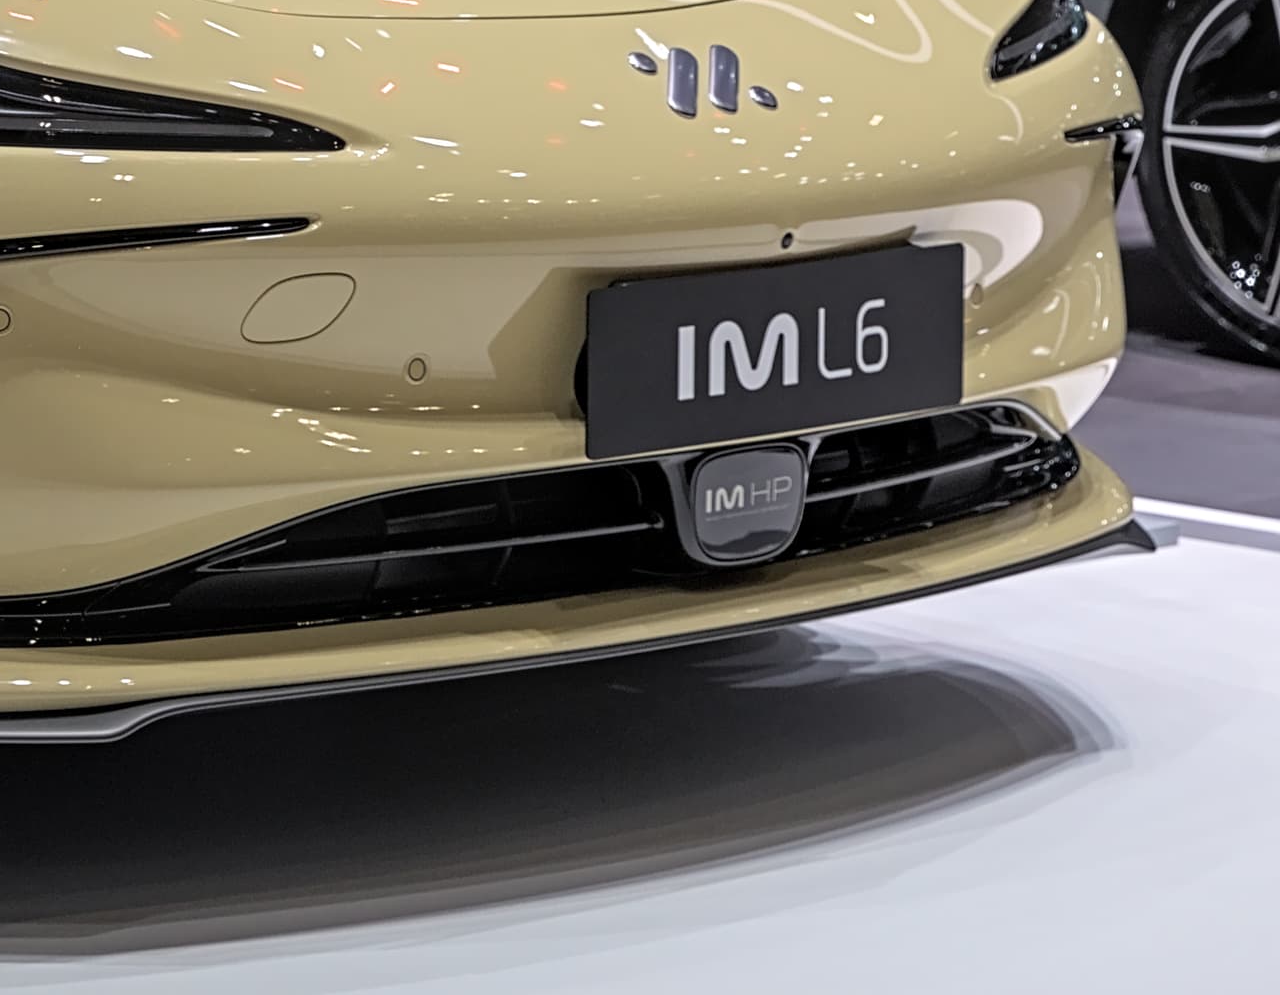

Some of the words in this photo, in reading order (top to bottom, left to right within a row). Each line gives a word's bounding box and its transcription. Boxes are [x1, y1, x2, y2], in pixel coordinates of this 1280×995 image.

[677, 312, 800, 401] IM
[817, 298, 889, 379] L6
[704, 484, 745, 514] IM
[750, 475, 793, 506] HP
